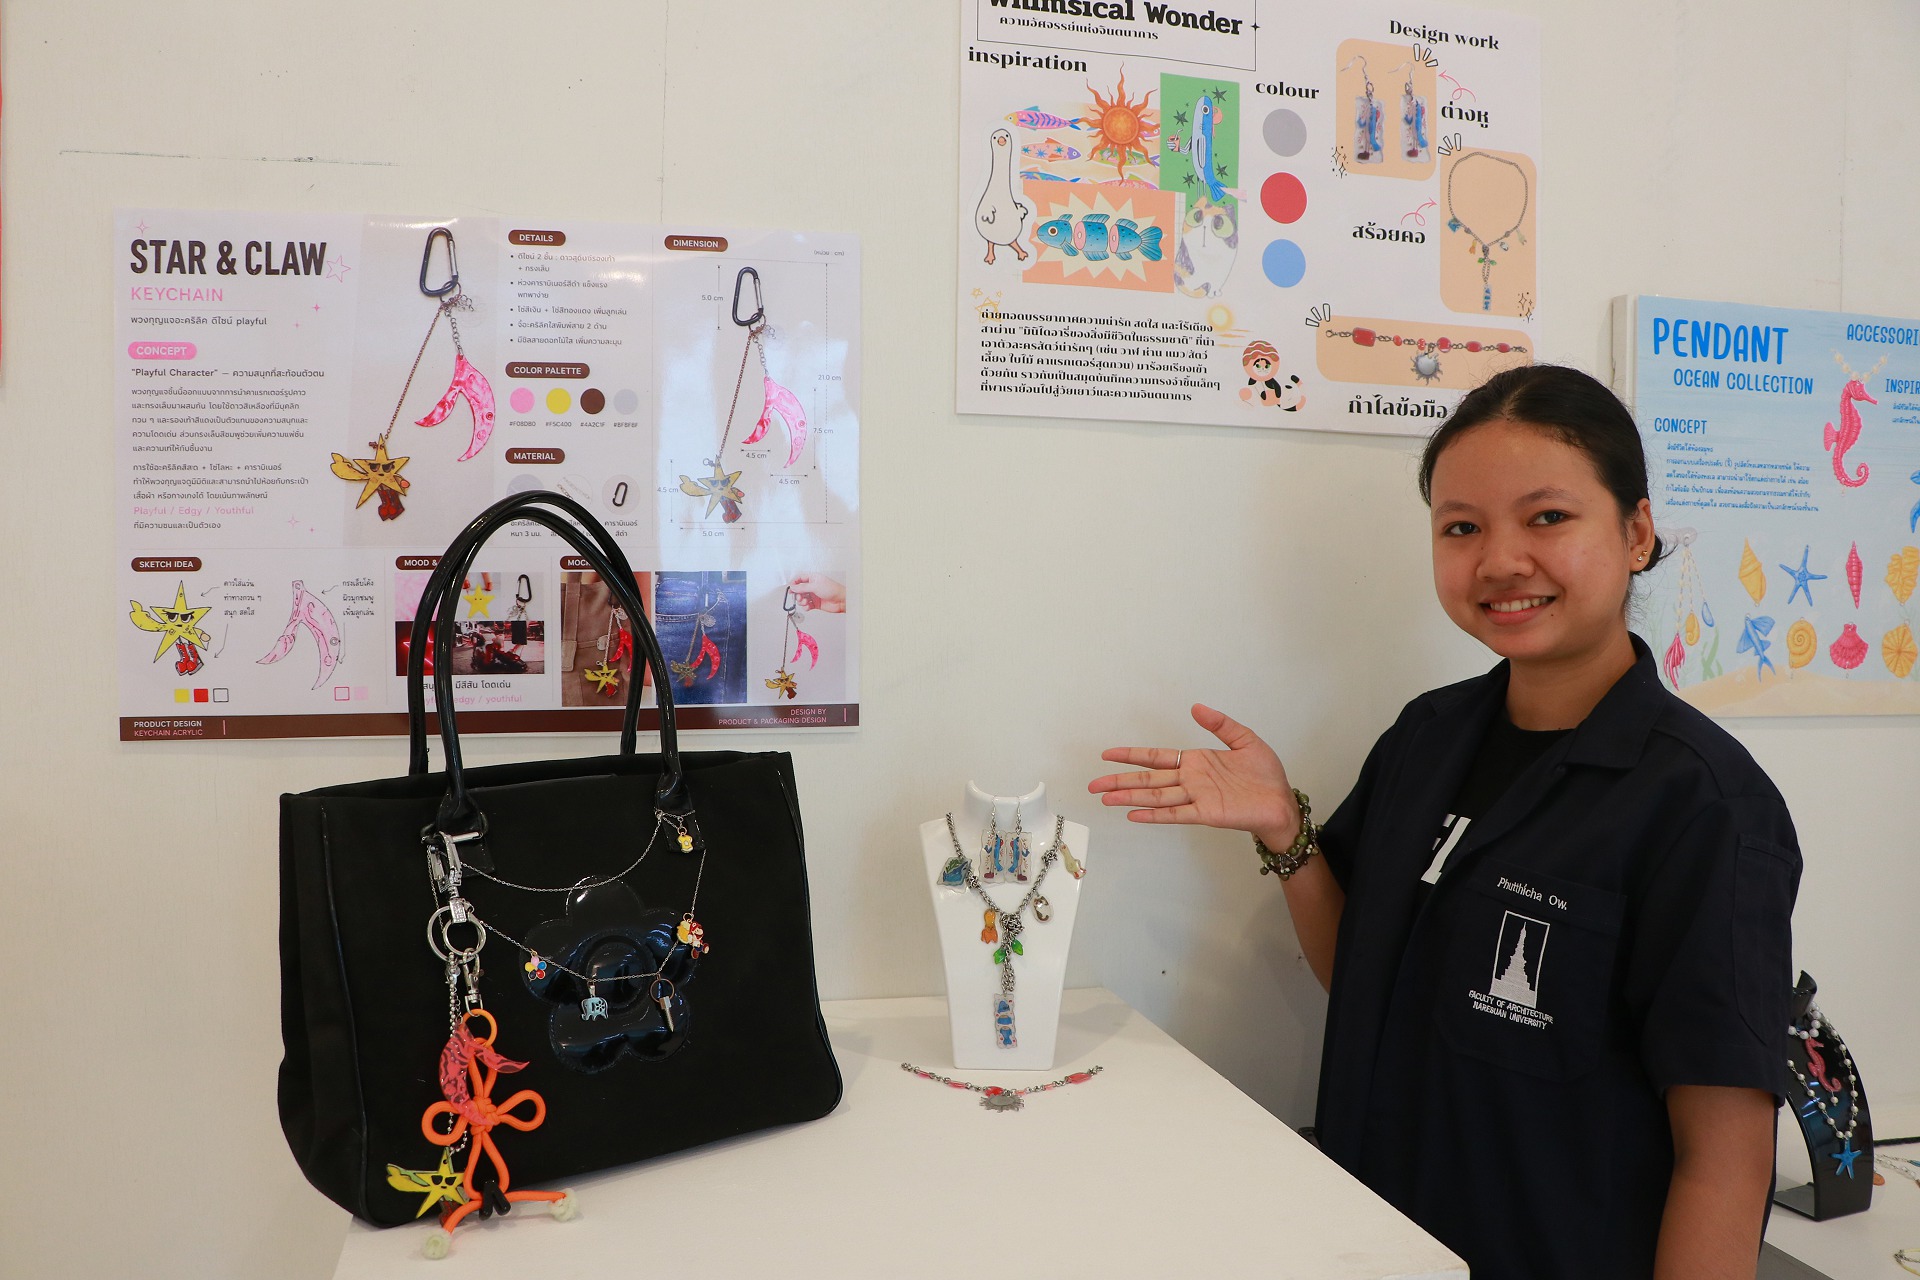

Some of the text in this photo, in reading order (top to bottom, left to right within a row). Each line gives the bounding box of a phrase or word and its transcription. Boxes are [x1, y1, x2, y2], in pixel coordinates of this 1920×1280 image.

[1144, 1, 1243, 36] Wonder
[1389, 18, 1500, 51] Design work
[967, 45, 1088, 74] inspiration
[1255, 80, 1320, 101] colour
[1441, 99, 1491, 128] ต่างหู
[519, 233, 554, 243] DETAILS
[1352, 221, 1427, 246] สร้อยคอ
[672, 239, 719, 249] DIMENSION
[130, 238, 327, 276] STAR & CLAW
[130, 286, 224, 302] KEYCHAIN
[236, 316, 268, 327] playful
[1133, 318, 1159, 329] สดใส
[1846, 323, 1920, 346] ACCESSORI
[1652, 316, 1790, 365] PENDANT
[136, 346, 187, 356] CONCEPT
[131, 368, 167, 378] "Playful
[169, 368, 218, 378] Character"
[513, 366, 582, 376] COLOR PALETTE
[1672, 367, 1814, 396] OCEAN COLLECTION
[812, 427, 824, 435] 7.5
[1654, 416, 1708, 436] CONCEPT
[513, 451, 556, 461] MATERIAL
[133, 506, 254, 517] Playful Edgy Youthful
[139, 560, 194, 569] SKETCH IDEA
[404, 559, 430, 567] MOOD
[485, 695, 523, 705] youthful
[789, 708, 828, 717] DESIGN BY
[133, 719, 203, 729] PRODUCT DESIGN
[718, 717, 752, 726] PRODUCT
[759, 716, 800, 725] PACKAGING
[801, 716, 827, 724] DESIGN
[133, 728, 203, 737] KEYCHAIN ACRYLIC
[1548, 894, 1568, 911] Ow.
[1468, 989, 1554, 1024] FACULTY OF ARCHITECTURE
[1472, 1000, 1548, 1030] NARESUAN UNIVERSITY
